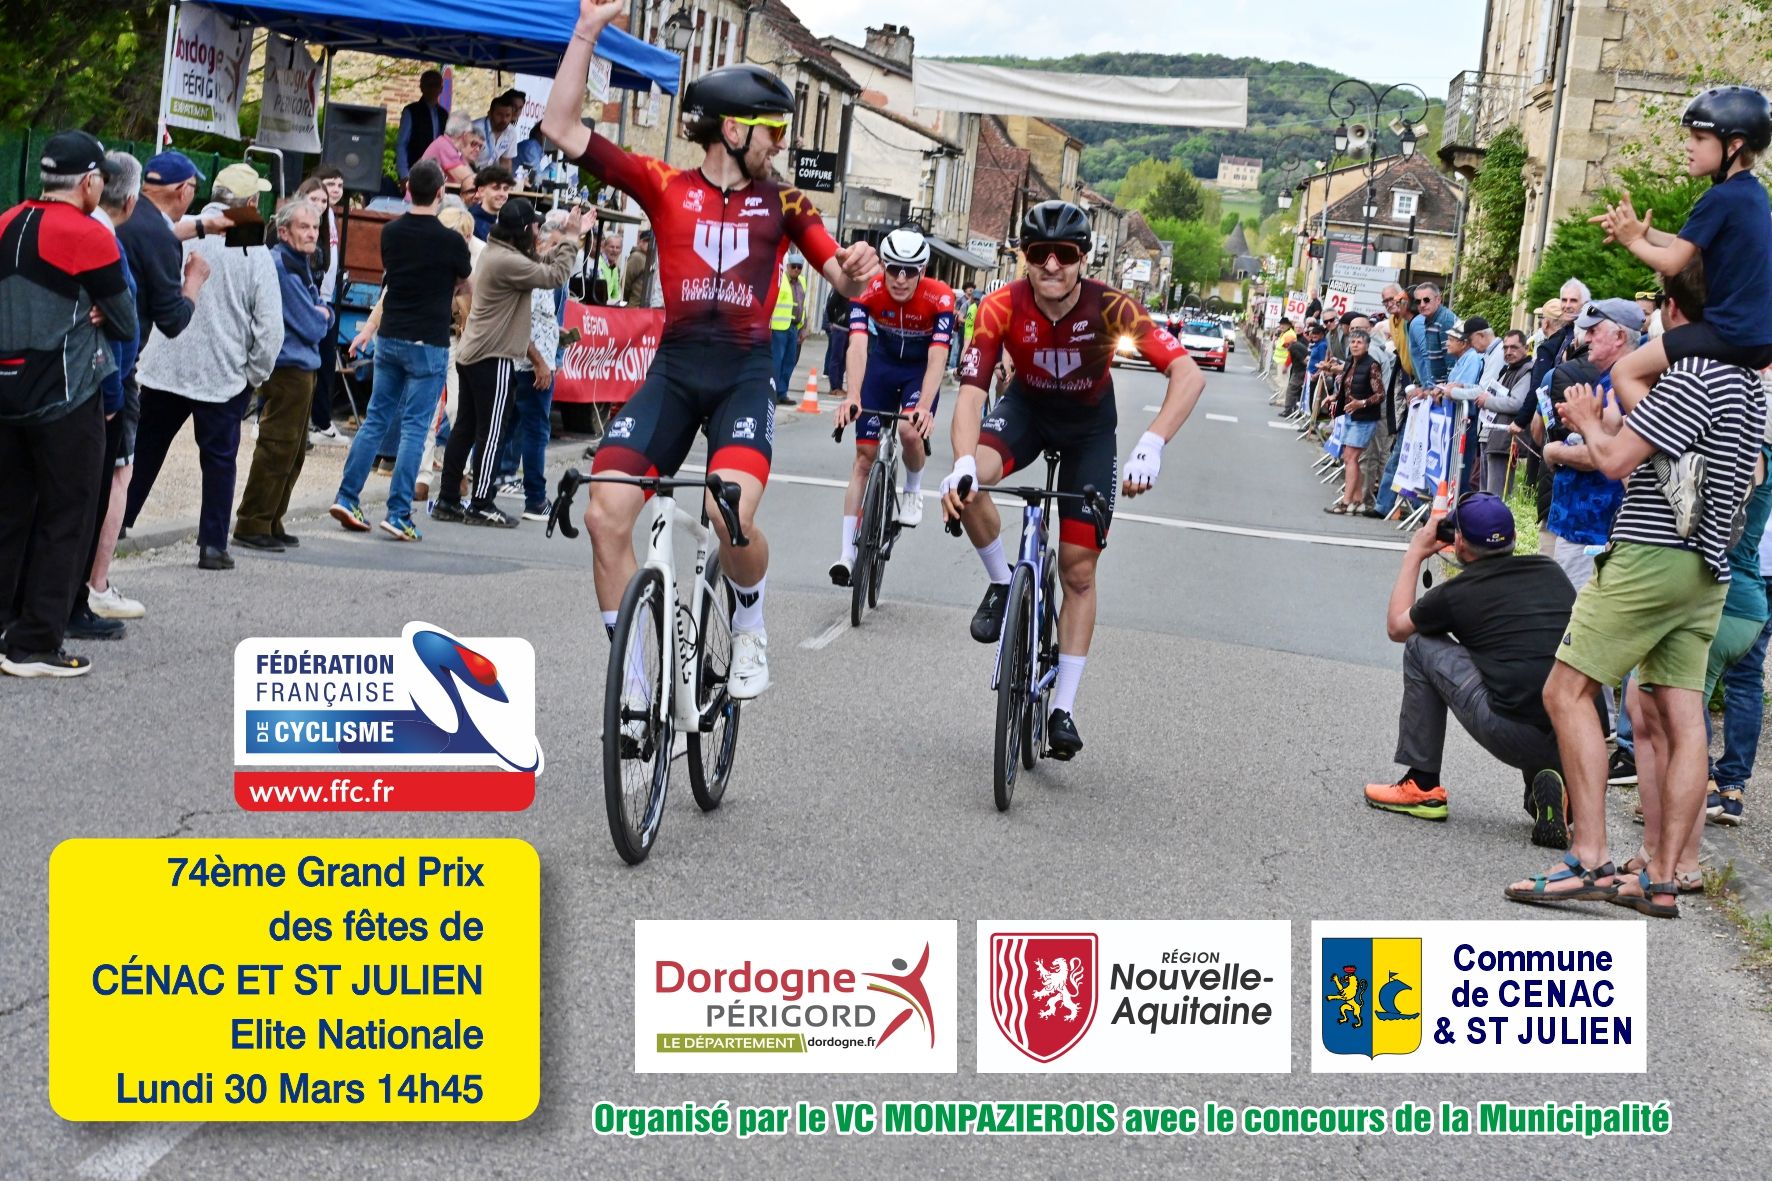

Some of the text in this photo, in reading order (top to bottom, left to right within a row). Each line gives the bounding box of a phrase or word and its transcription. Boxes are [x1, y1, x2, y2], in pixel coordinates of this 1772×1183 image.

[799, 168, 832, 180] COIFFURE
[971, 240, 995, 248] CAVE
[1269, 304, 1279, 316] 75
[1287, 301, 1306, 314] 50
[1331, 295, 1348, 316] 25
[582, 310, 609, 337] RÉGION
